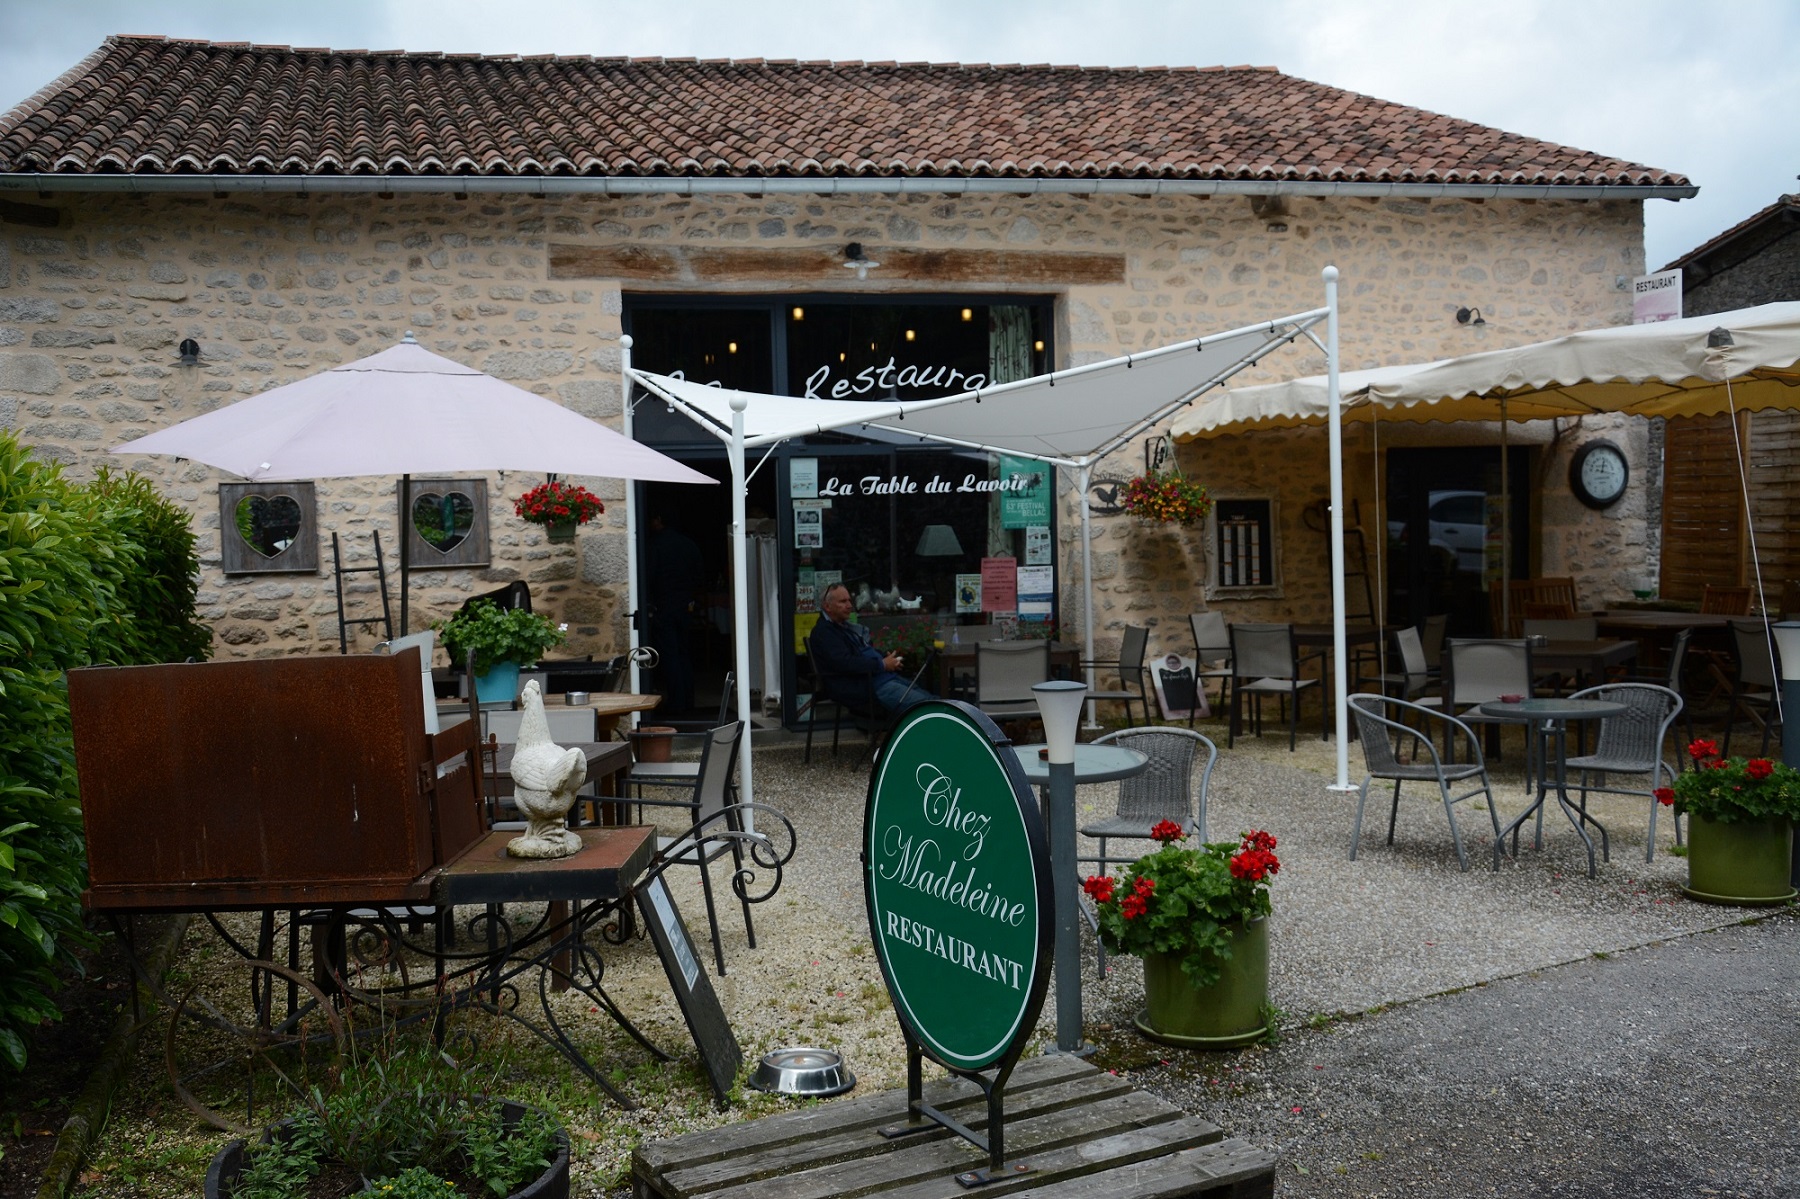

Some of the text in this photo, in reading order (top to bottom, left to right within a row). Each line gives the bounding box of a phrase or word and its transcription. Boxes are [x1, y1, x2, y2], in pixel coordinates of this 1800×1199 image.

[1636, 276, 1676, 293] RESTAURANT
[804, 357, 998, 399] Restaura
[819, 474, 1028, 496] La Table du Lavoir
[1017, 502, 1045, 510] FESTIVAL
[1022, 509, 1046, 517] BELLAC
[916, 763, 991, 861] Chez
[879, 825, 1025, 927] Madeleine
[886, 910, 1023, 991] RESTAURANT
